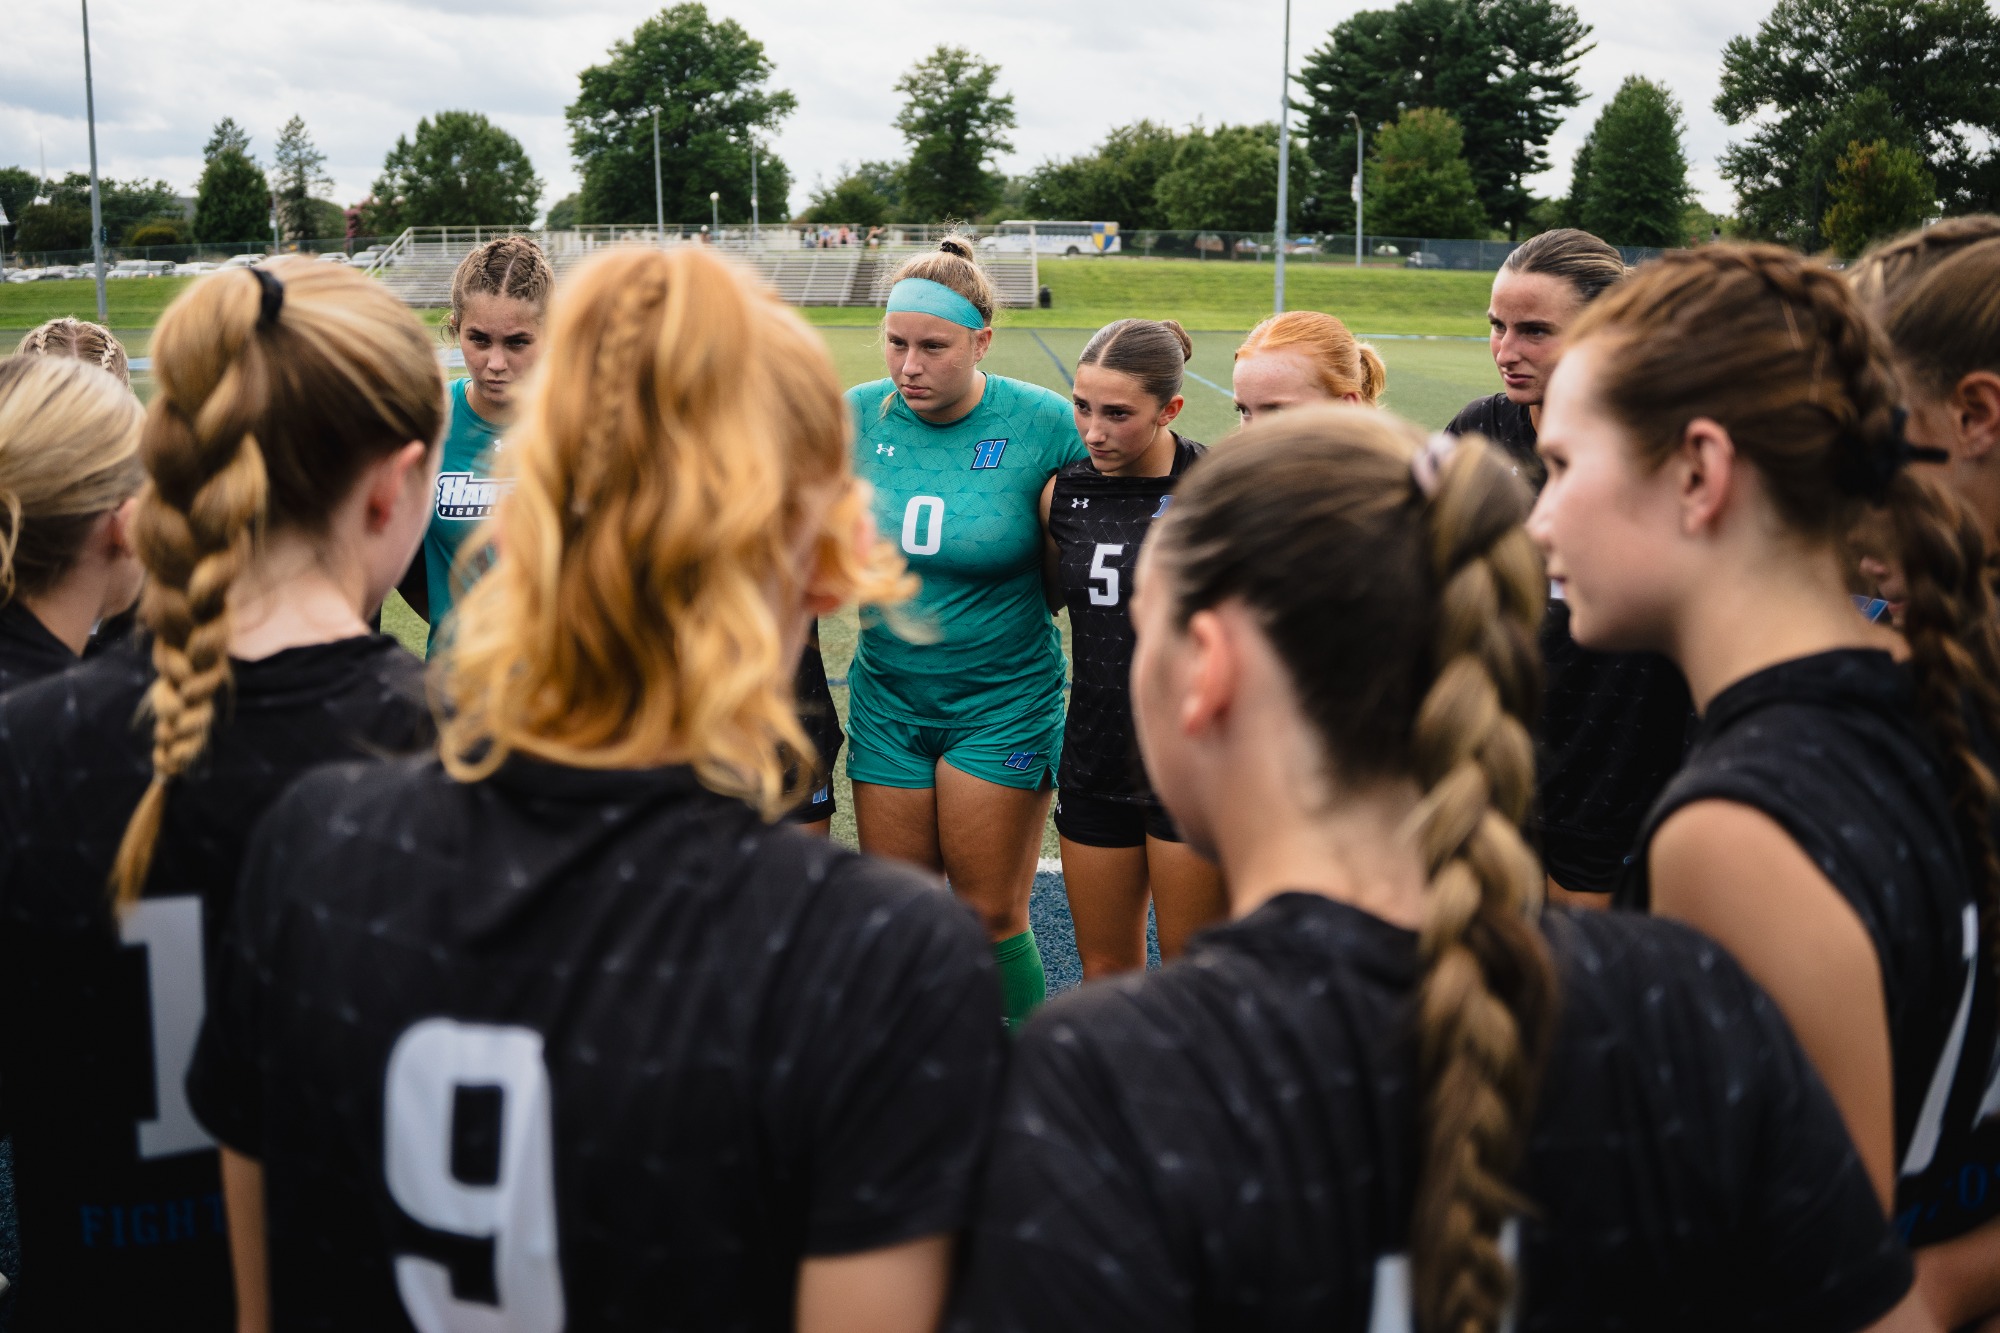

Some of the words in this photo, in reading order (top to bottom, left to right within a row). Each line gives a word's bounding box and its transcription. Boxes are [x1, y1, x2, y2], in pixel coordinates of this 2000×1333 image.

[971, 438, 1008, 470] H
[902, 496, 945, 555] 0
[1088, 543, 1124, 606] 5
[384, 1017, 565, 1333] 9
